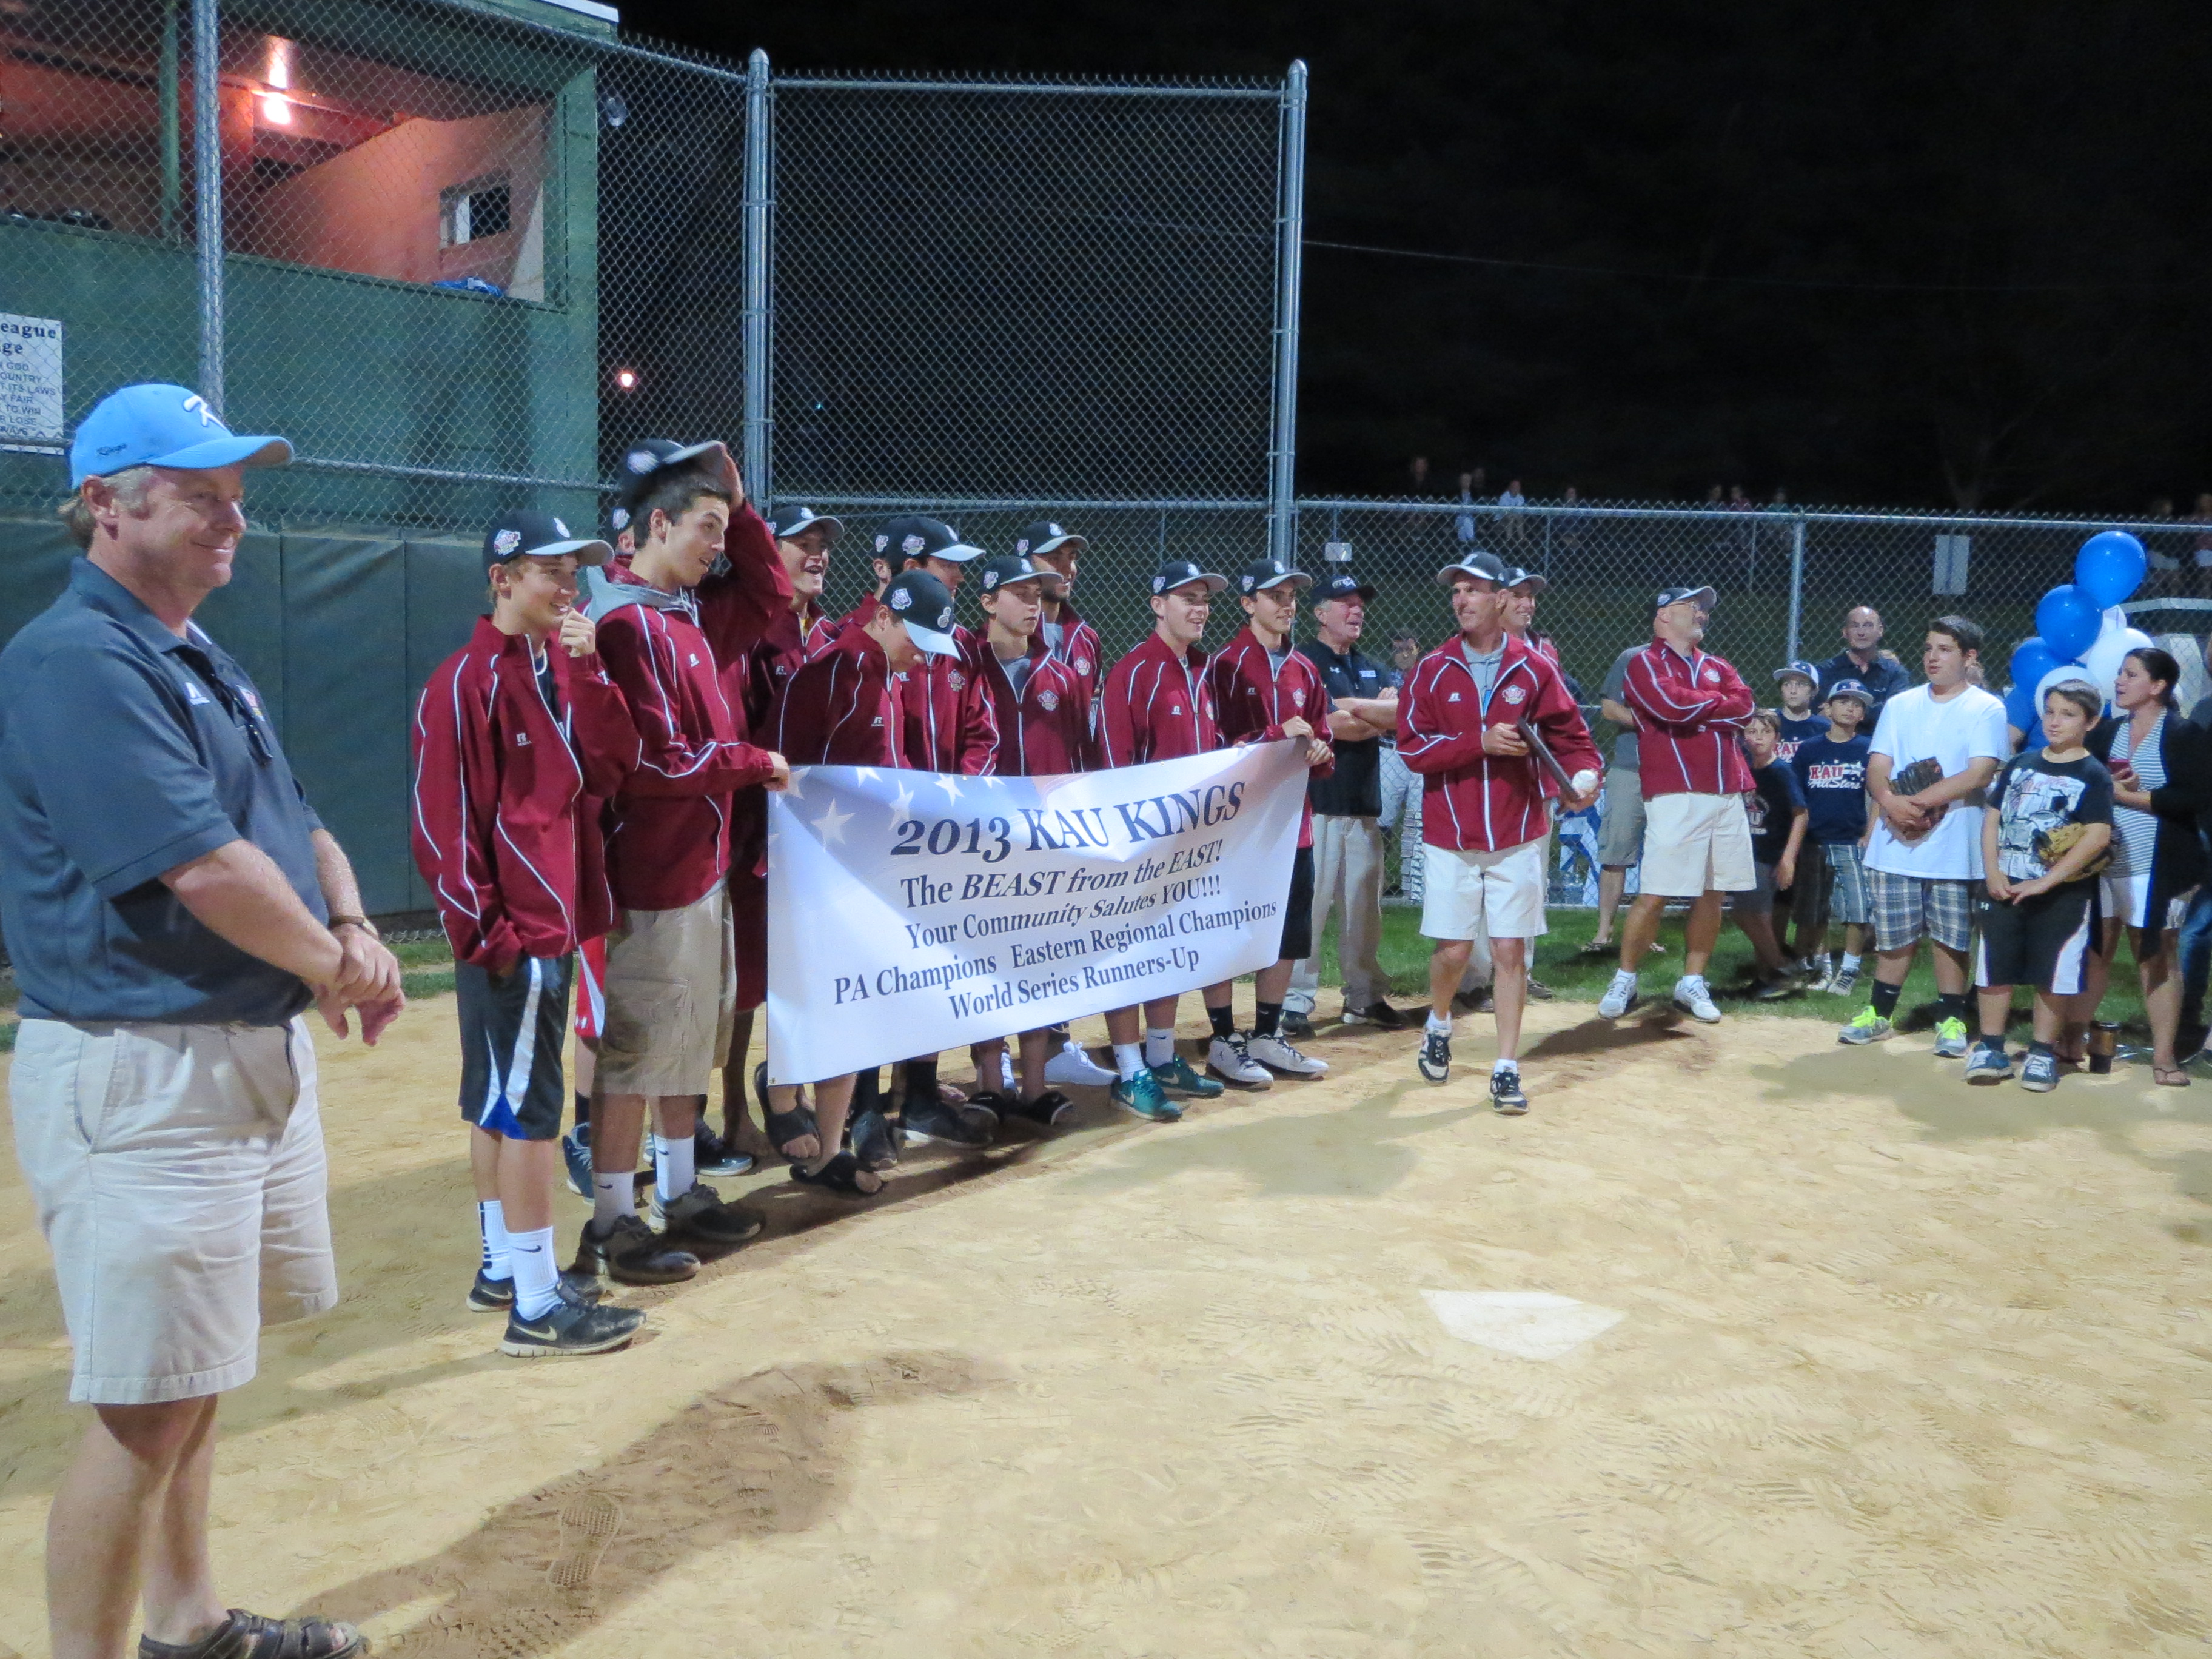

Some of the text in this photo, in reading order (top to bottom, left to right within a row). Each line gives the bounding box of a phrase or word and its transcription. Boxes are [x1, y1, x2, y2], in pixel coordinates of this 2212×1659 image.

[0, 343, 24, 357] ge
[6, 362, 29, 371] GOD
[27, 386, 56, 396] LAWS
[10, 394, 33, 403] FAIR
[5, 404, 18, 413] TO
[10, 416, 36, 425] LOSE
[890, 781, 1245, 863] 2013 KAU KINGS
[900, 839, 1224, 908] The BEAST from the EAST!
[905, 874, 1221, 950] Your Community Salutes YOU!!!
[834, 900, 1277, 1005] PA Champions Eastern Regional Champions
[948, 946, 1199, 1020] World Series Runners-Up
